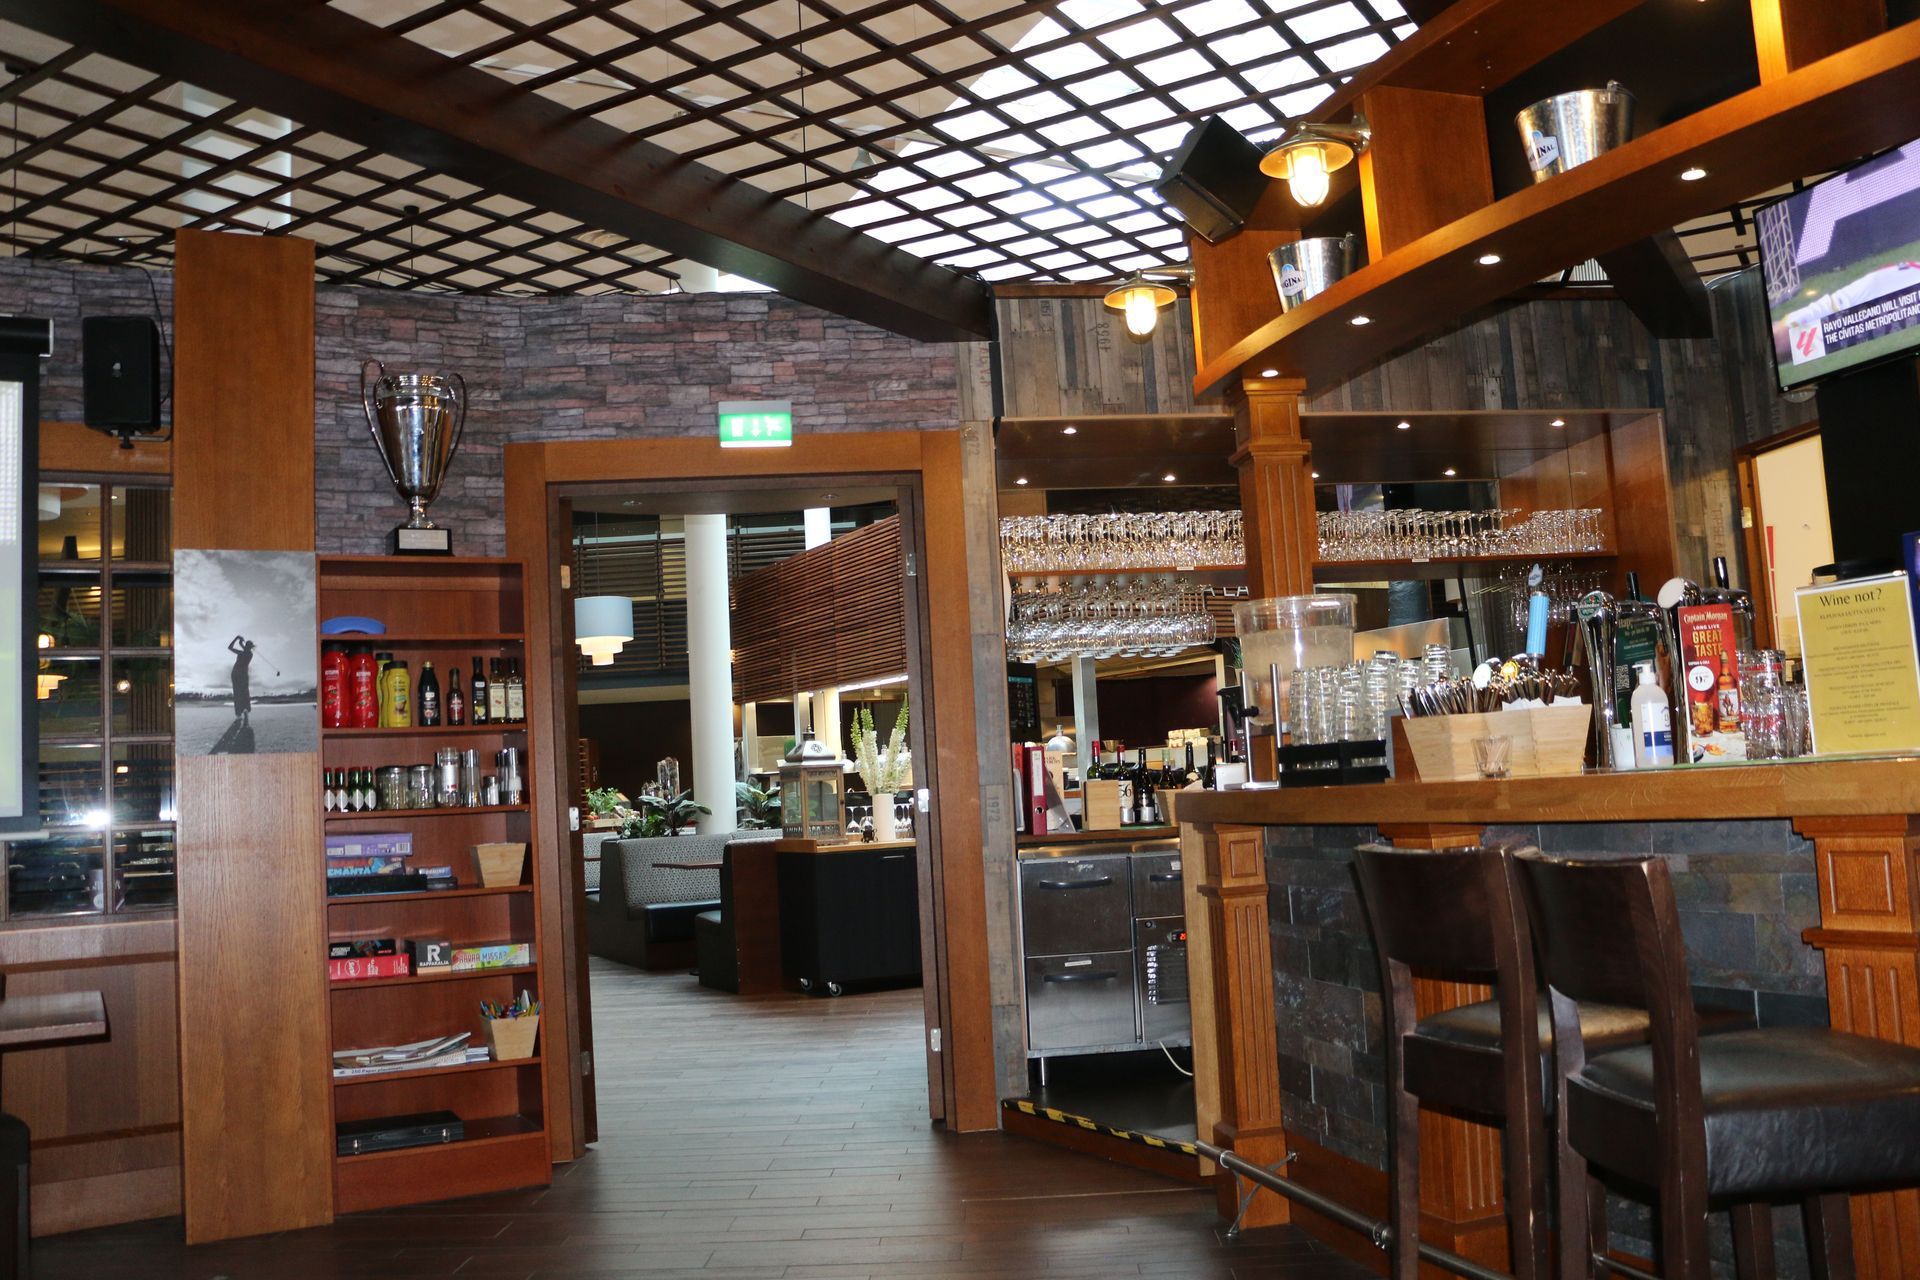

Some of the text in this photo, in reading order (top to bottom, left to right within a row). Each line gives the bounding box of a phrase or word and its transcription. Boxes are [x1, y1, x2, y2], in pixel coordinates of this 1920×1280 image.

[1823, 318, 1843, 333] RAYO
[1842, 305, 1881, 326] VALLECANO
[1881, 299, 1899, 313] WILL
[1899, 291, 1918, 307] VISIT
[1825, 332, 1839, 345] THE
[1819, 588, 1882, 607] Wine not?
[1684, 610, 1728, 624] Captain Morgan
[1692, 630, 1723, 644] GREAT
[1694, 643, 1723, 658] TASTE
[427, 944, 441, 962] R
